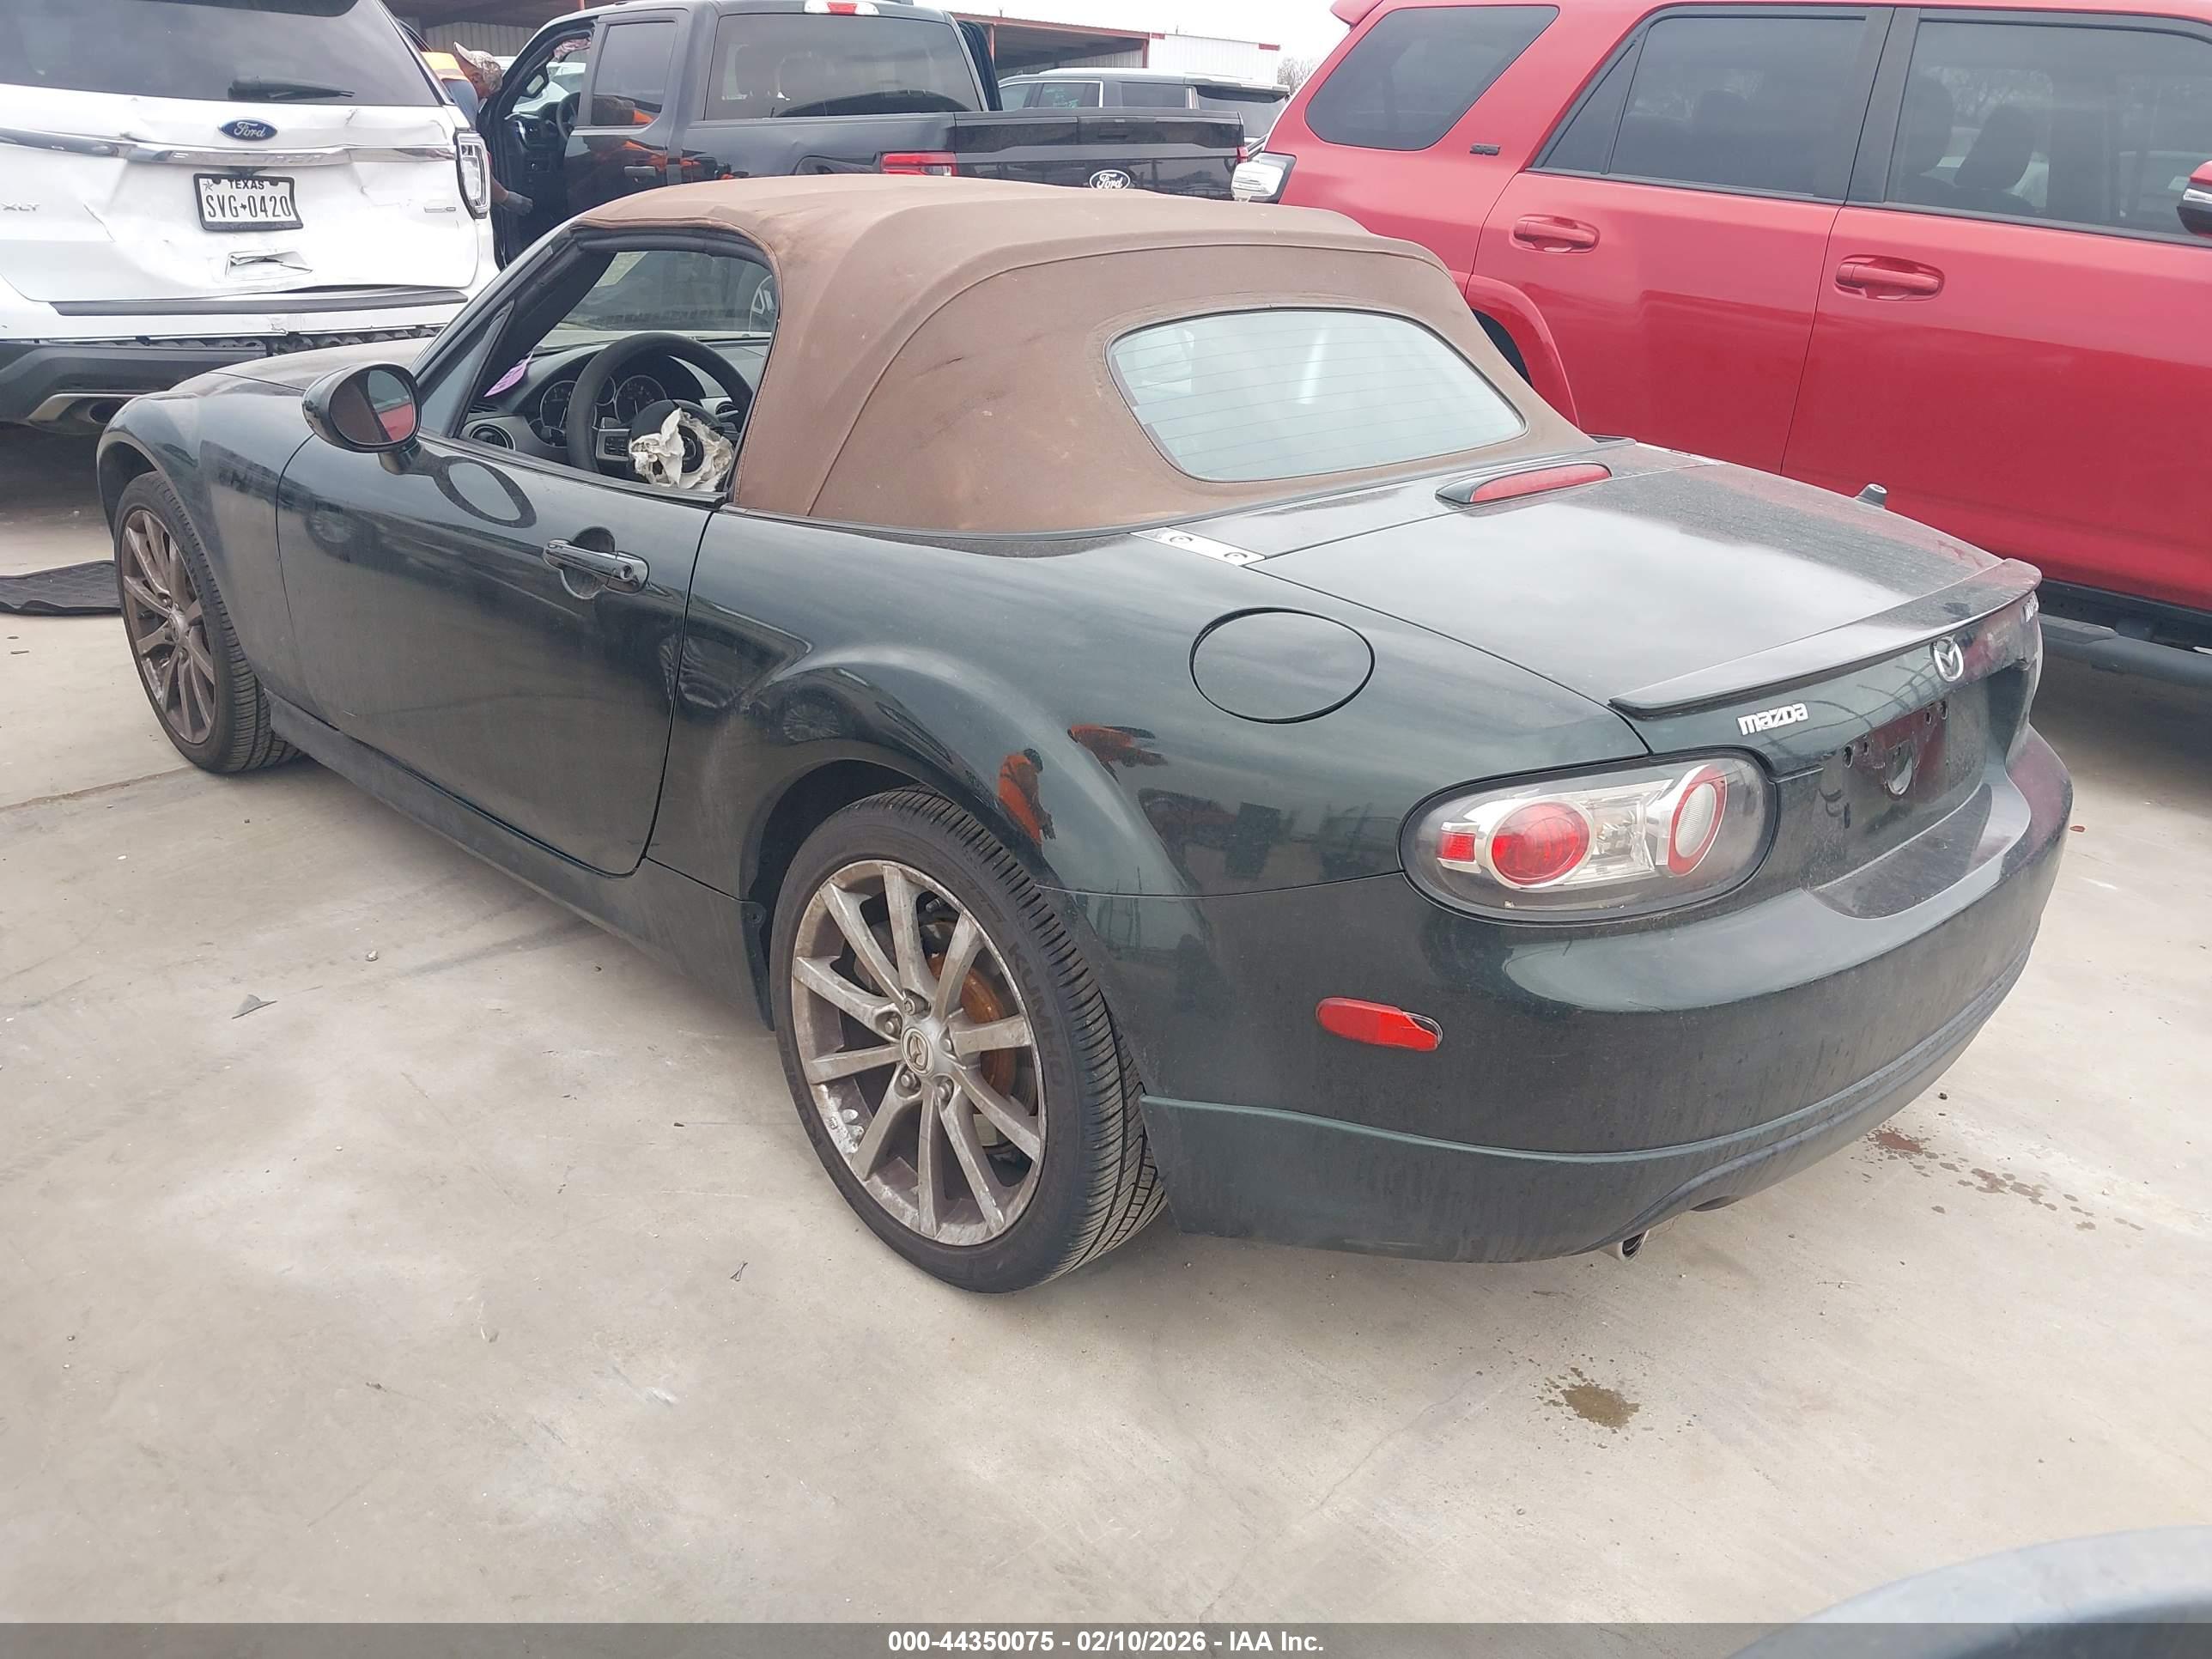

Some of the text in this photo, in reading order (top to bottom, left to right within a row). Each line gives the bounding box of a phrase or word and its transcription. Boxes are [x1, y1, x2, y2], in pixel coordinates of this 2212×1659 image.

[234, 121, 266, 137] Ford
[228, 179, 265, 190] TEXAS
[1097, 173, 1123, 189] Ford
[1007, 940, 1066, 1088] KUMHO
